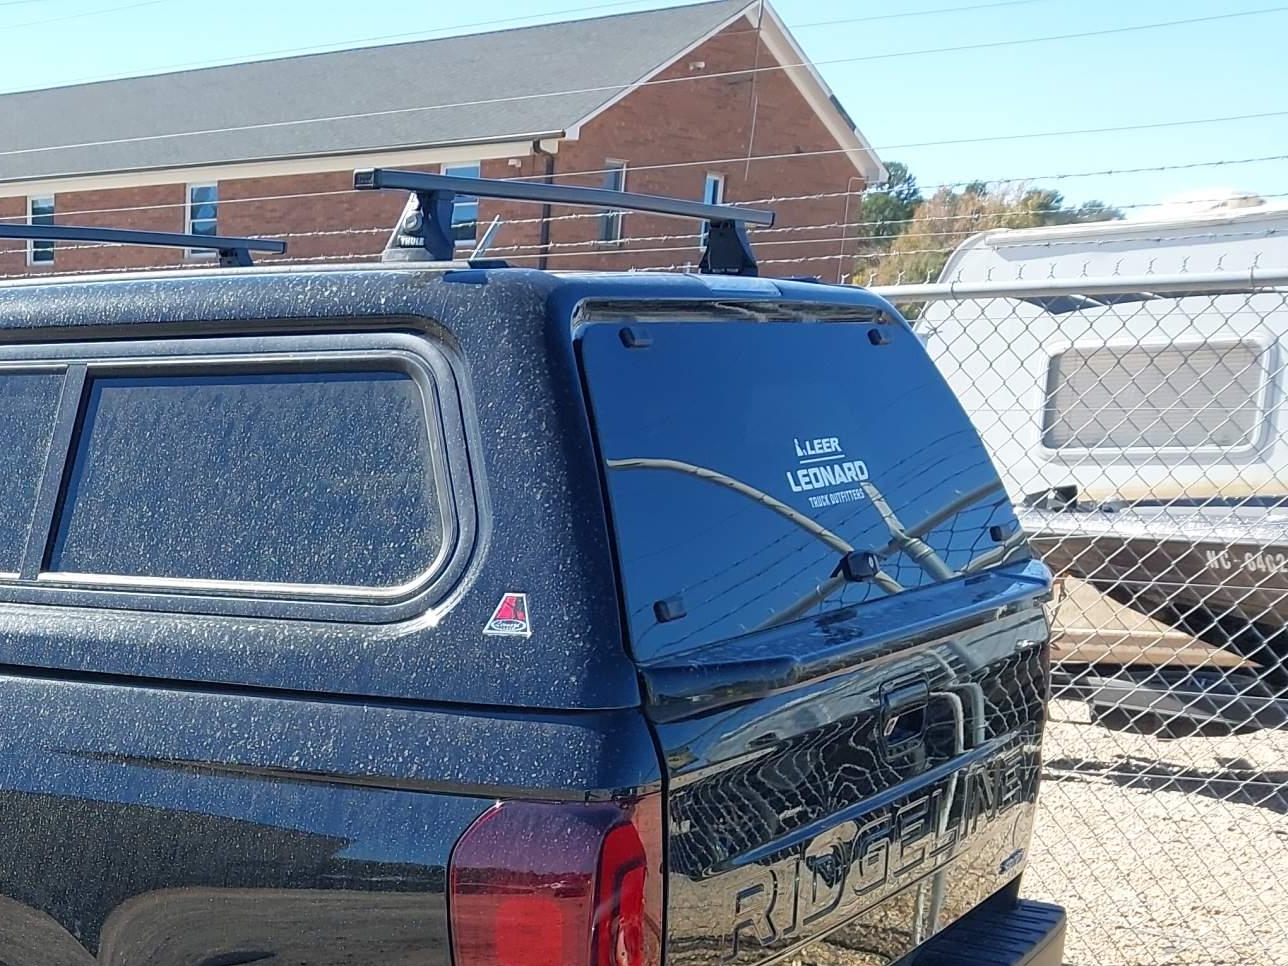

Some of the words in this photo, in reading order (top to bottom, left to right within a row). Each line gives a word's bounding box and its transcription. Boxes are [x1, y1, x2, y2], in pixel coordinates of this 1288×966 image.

[805, 437, 842, 456] LEER
[786, 460, 869, 492] LEONARD
[808, 494, 831, 508] TRUCK
[829, 488, 865, 505] OUTFITTERS
[720, 742, 1025, 962] RIDGELINE
